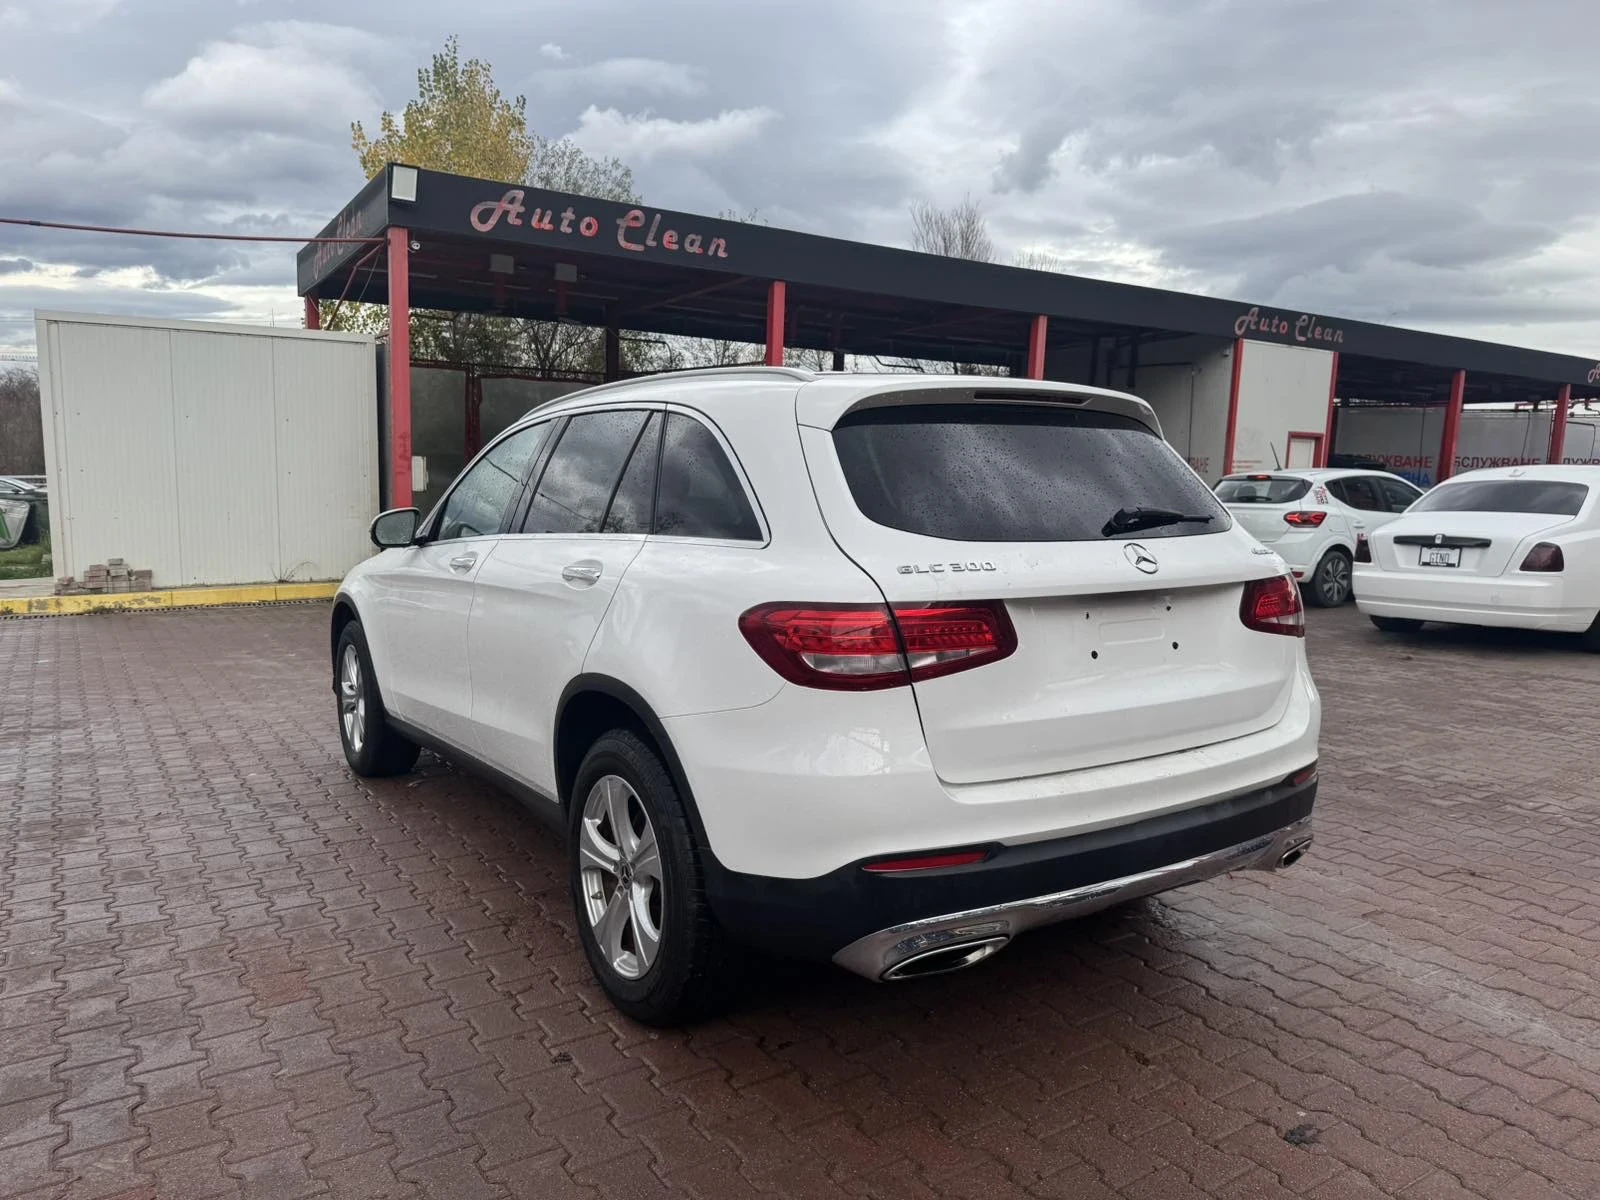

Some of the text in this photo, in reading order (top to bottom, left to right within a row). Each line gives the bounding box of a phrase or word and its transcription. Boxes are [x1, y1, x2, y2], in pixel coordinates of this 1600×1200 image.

[470, 189, 728, 258] Auto Clean
[1234, 306, 1344, 343] Auto Clean
[896, 561, 997, 575] GLC 300
